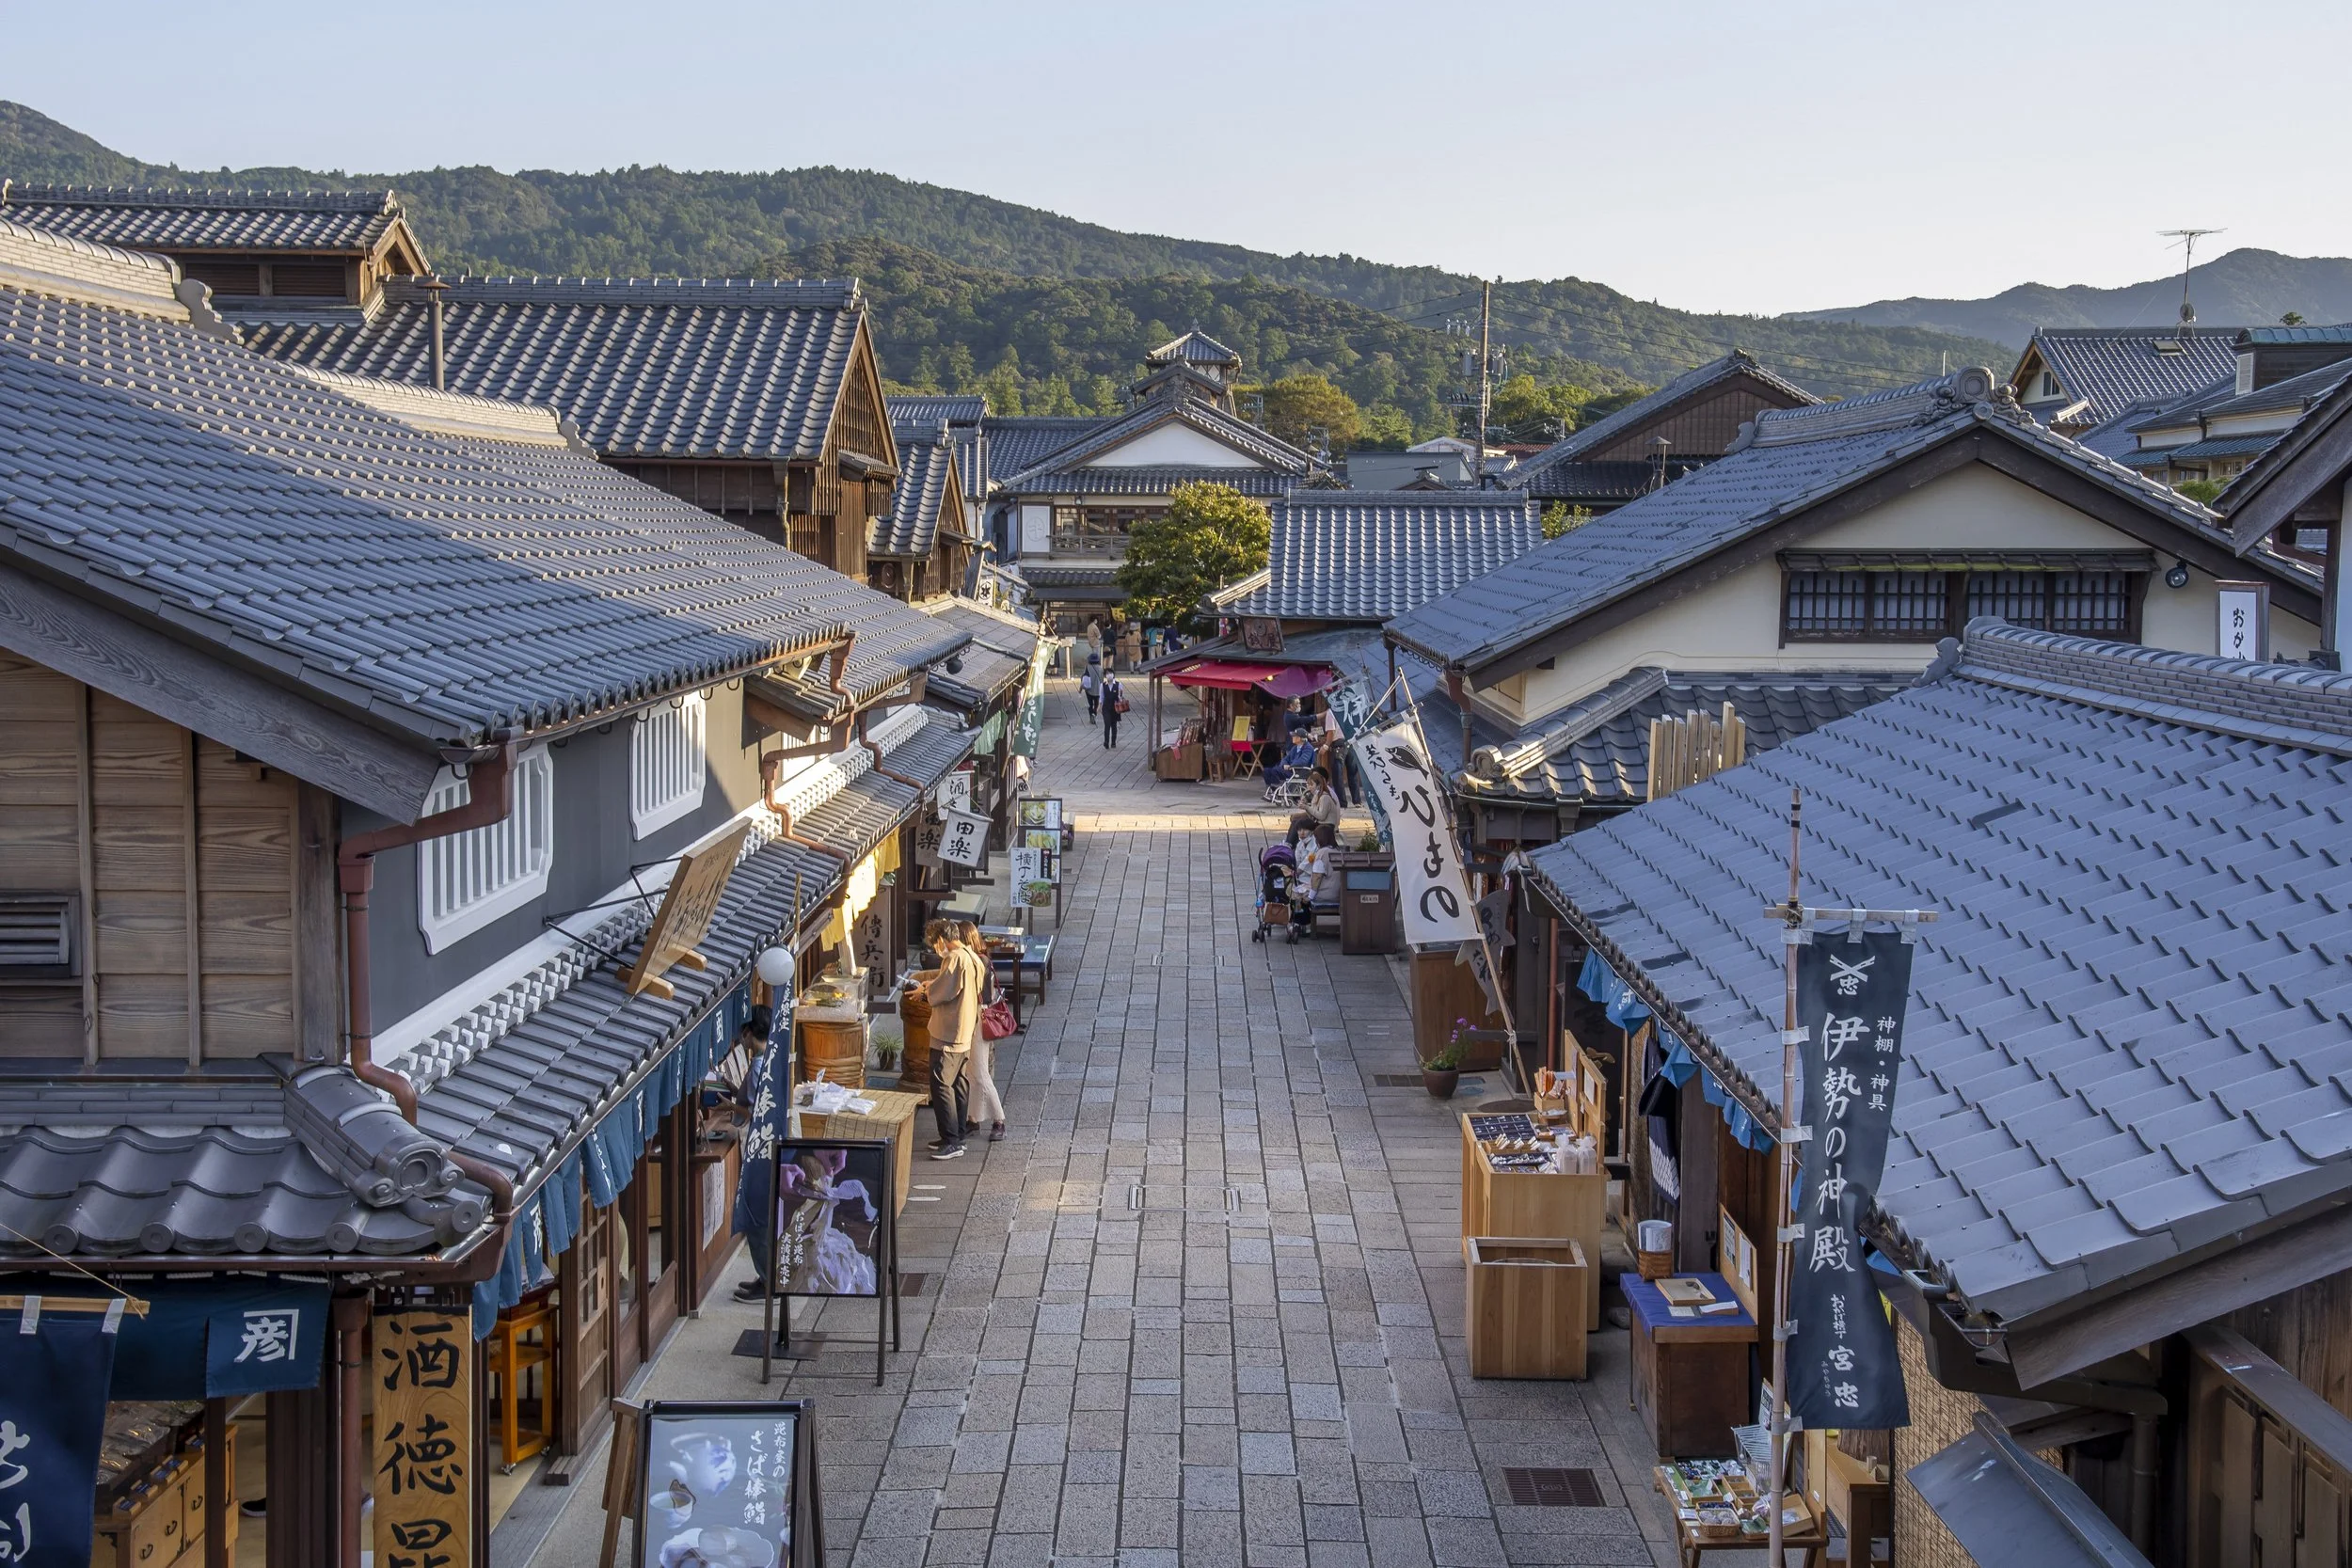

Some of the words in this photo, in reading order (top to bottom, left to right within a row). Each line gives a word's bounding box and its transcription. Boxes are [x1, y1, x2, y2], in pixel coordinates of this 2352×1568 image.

[947, 821, 975, 859] 田楽
[1836, 975, 1859, 996] 忠
[1867, 1016, 1897, 1112] 神棚・神具
[1810, 1012, 1870, 1273] 伊勢の神殿
[1828, 1344, 1859, 1408] 宮忠
[743, 1430, 768, 1526] さば棒鮨
